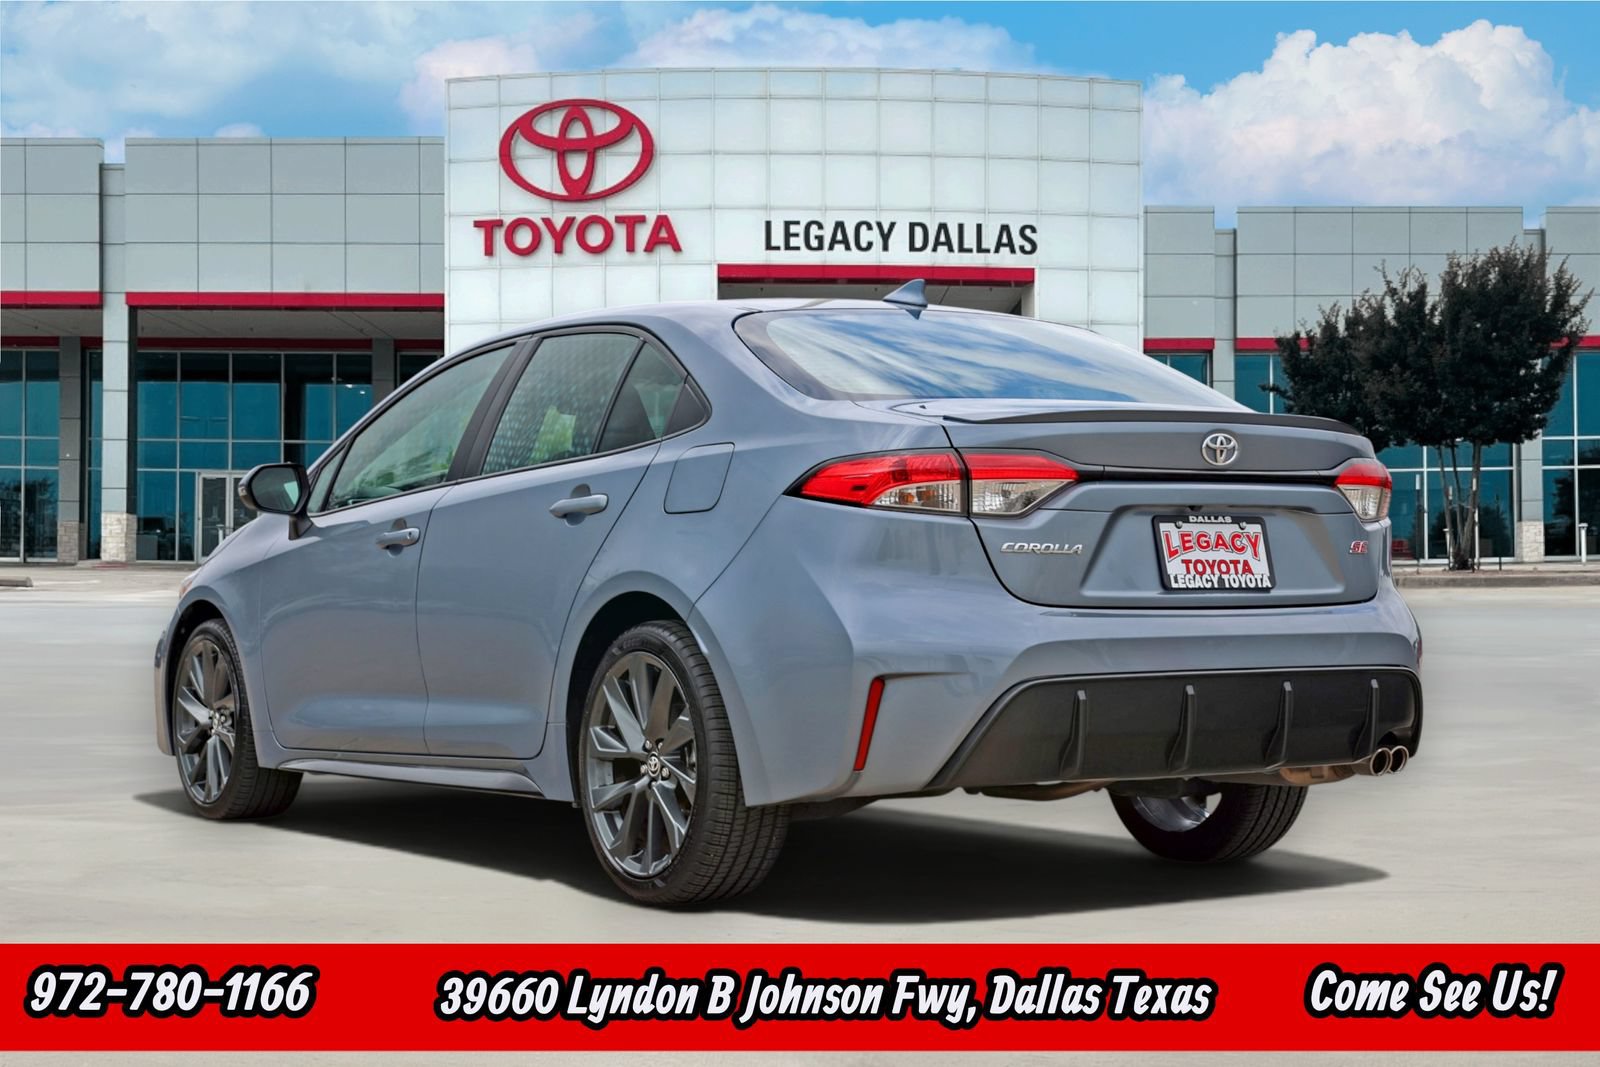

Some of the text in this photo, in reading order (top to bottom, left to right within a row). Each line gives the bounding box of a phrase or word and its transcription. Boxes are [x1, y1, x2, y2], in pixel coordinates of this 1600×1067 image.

[474, 214, 682, 256] TOYOTA
[765, 220, 1038, 255] LEGACY DALLAS
[1188, 515, 1233, 523] DALLAS
[1000, 542, 1083, 554] COROLLA
[1162, 530, 1262, 563] LEGACY
[1181, 558, 1255, 576] TOYOTA
[1169, 573, 1273, 589] LEGACY TOYOTA
